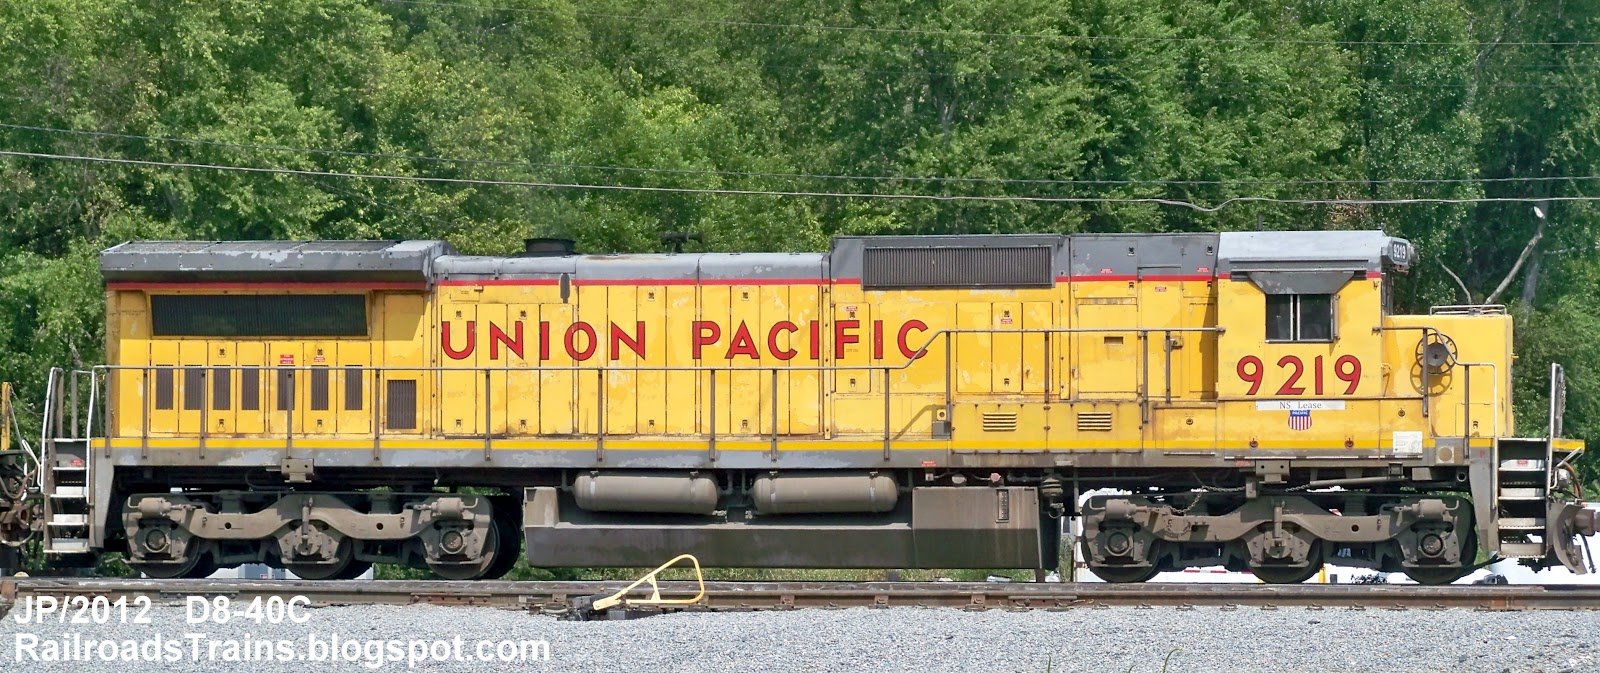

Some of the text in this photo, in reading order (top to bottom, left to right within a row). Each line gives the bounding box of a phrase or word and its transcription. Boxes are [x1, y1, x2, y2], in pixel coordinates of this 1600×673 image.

[1393, 243, 1406, 260] 9219
[441, 319, 929, 361] UNION PACIFIC
[1236, 355, 1362, 395] 9219
[1279, 401, 1322, 409] NS Lease
